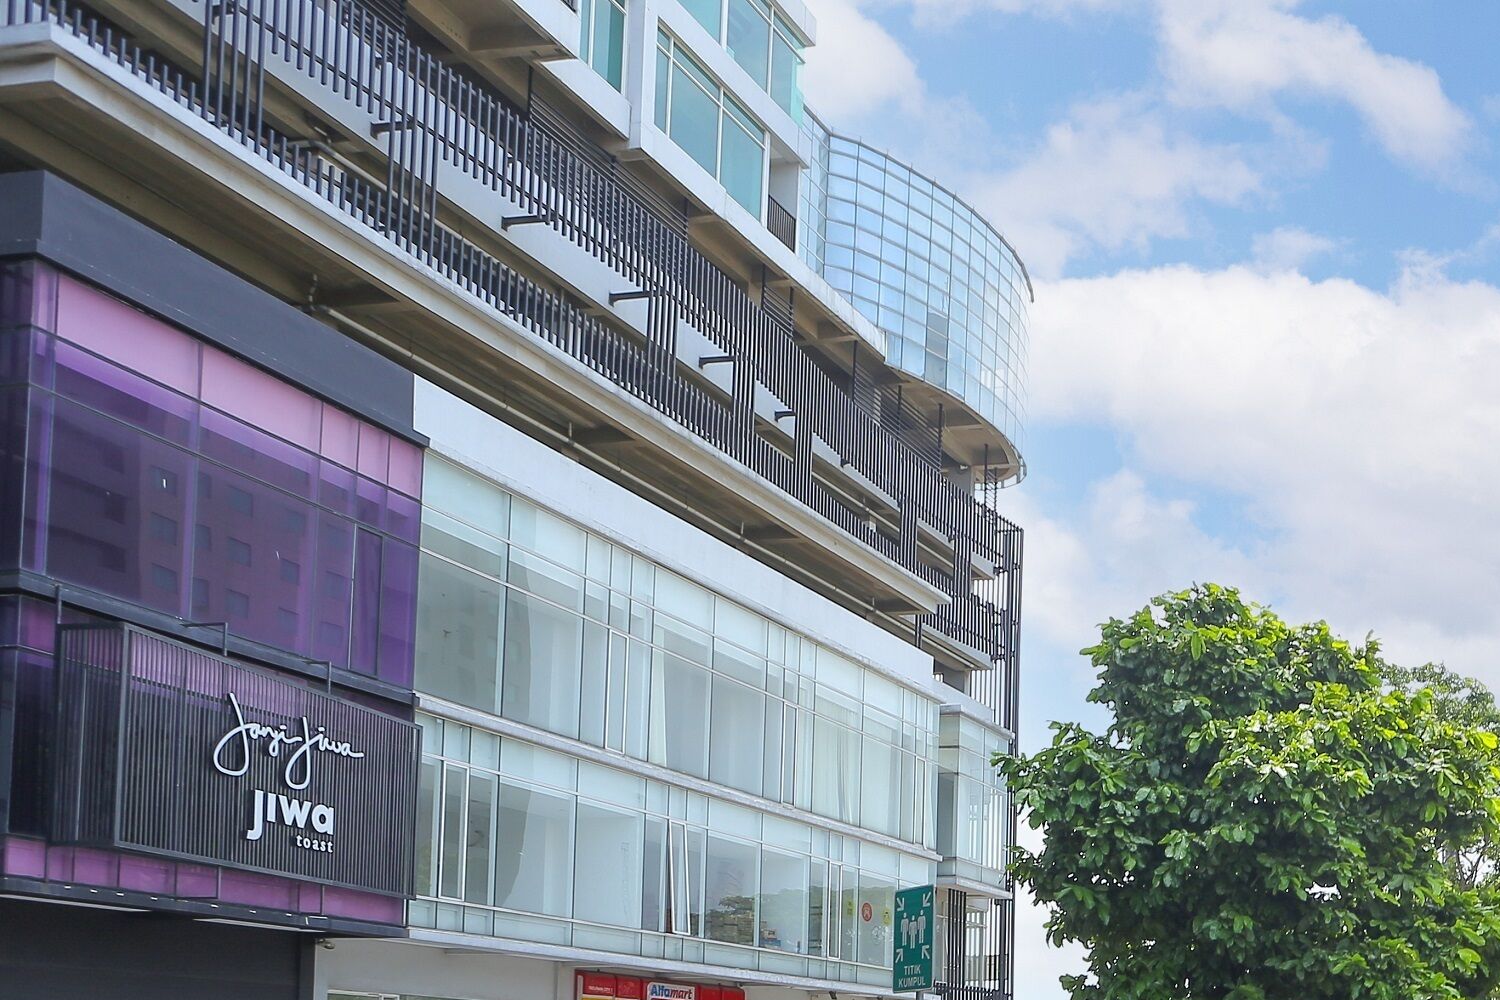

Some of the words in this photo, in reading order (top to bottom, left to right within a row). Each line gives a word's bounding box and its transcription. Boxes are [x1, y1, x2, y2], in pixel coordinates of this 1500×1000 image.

[285, 717, 364, 790] Jiwa
[296, 834, 333, 853] toast
[904, 964, 921, 976] TITIK
[898, 976, 926, 988] KUMPUL
[650, 984, 692, 1000] Alfamart
